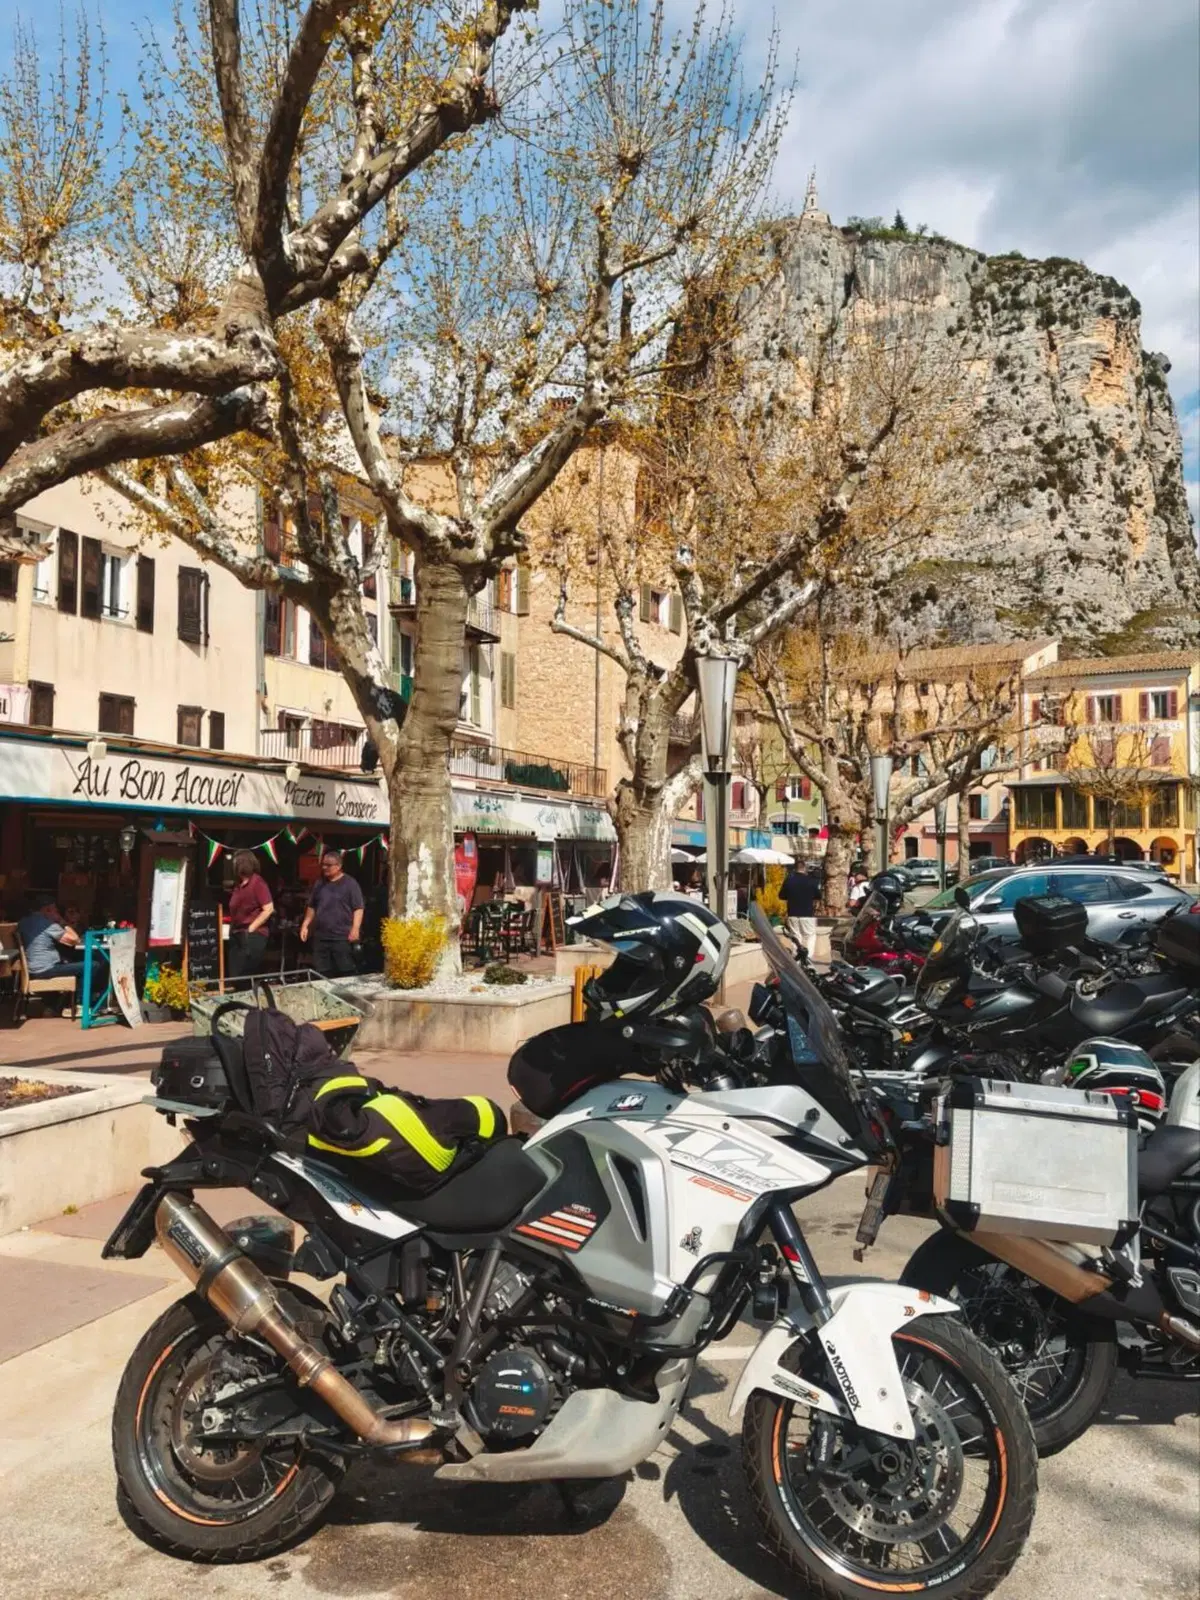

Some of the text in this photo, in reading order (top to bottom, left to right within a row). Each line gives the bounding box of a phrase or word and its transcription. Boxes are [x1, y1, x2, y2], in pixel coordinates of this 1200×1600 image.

[73, 756, 245, 807] Au Bon Accueil
[284, 780, 327, 808] Pizzeria
[336, 791, 378, 820] Brasserie
[831, 1355, 862, 1412] MOTOREX
